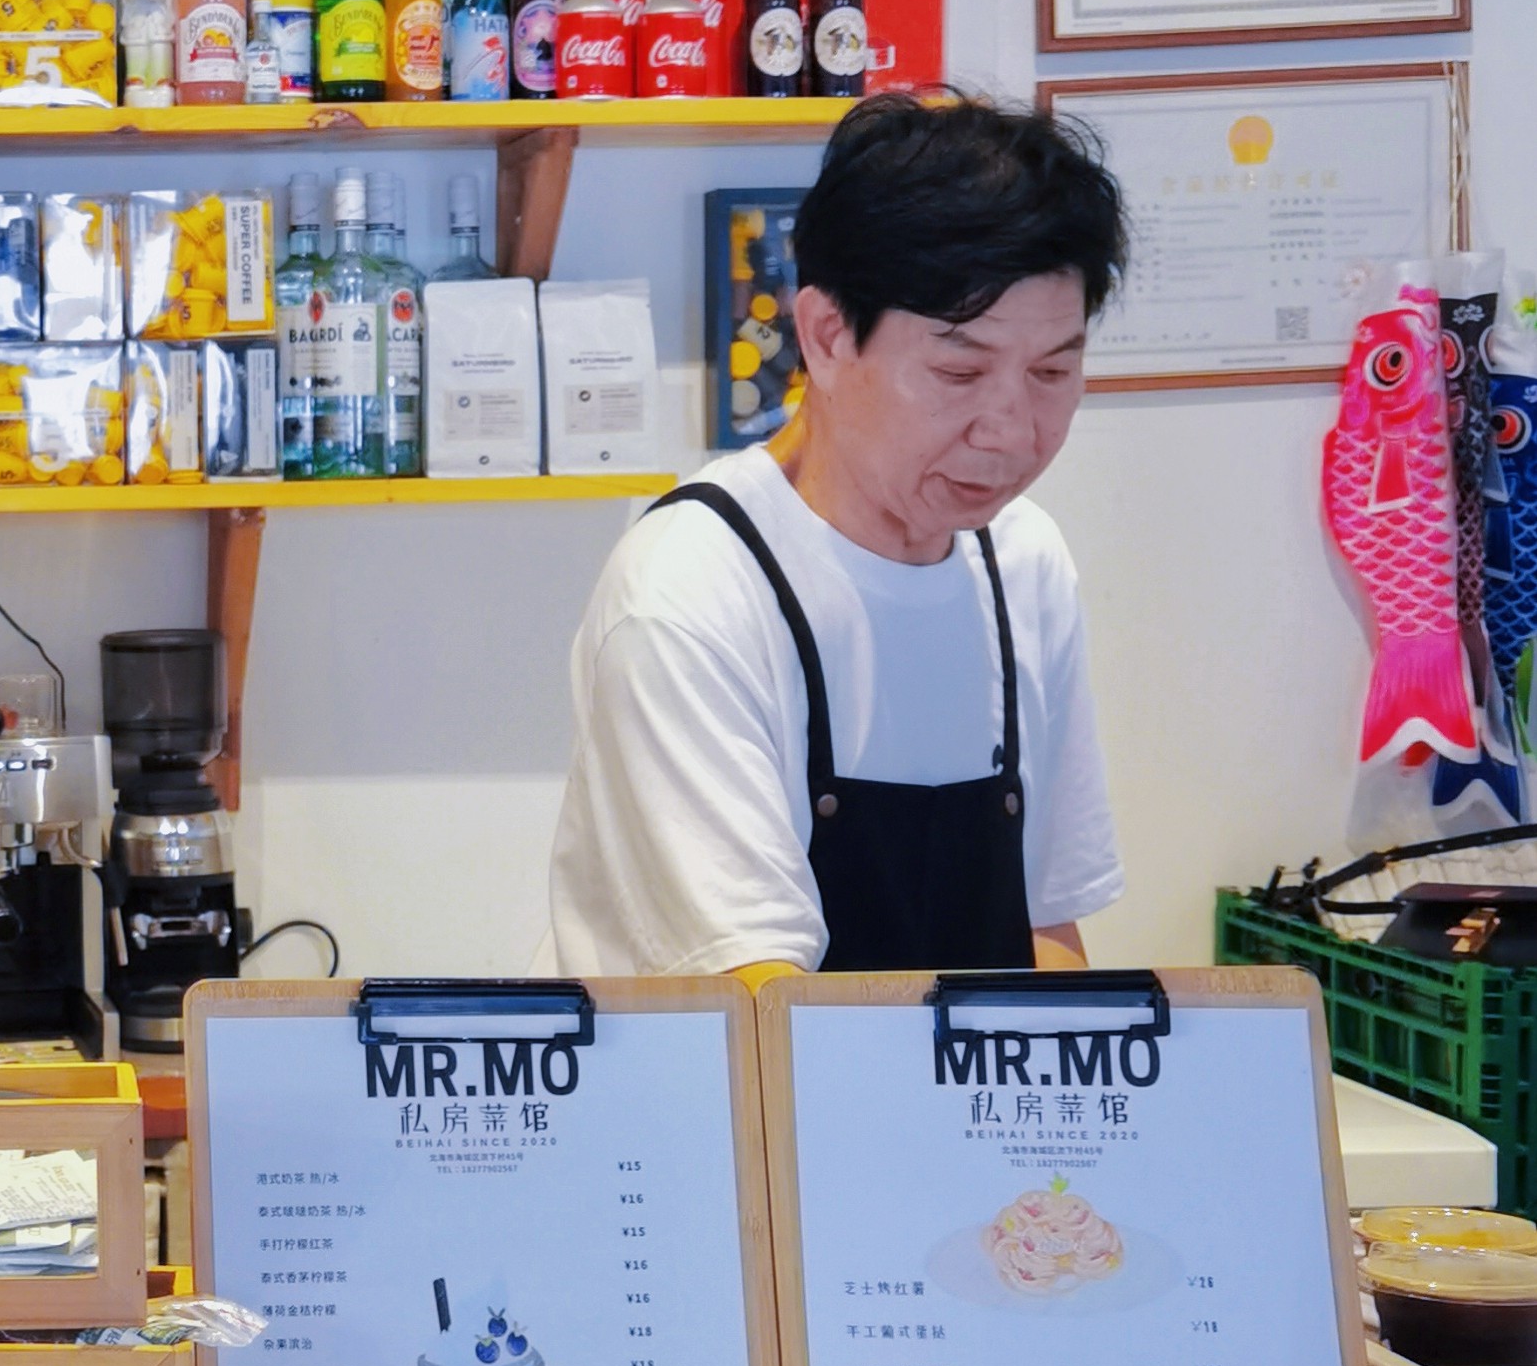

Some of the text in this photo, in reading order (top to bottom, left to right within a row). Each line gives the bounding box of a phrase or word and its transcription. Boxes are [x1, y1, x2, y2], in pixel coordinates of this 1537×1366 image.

[240, 206, 253, 305] SUPER COFFEE
[365, 1044, 580, 1098] MR.MO
[934, 1032, 1161, 1086] MR.MO
[399, 1102, 551, 1133] 私房菜馆
[970, 1092, 1129, 1125] 私房菜馆
[395, 1139, 452, 1148] BEIHAI
[462, 1138, 510, 1146] SINCE
[965, 1130, 1139, 1140] BEIHAI SINCE 2020
[257, 1173, 305, 1185] 港式奶茶
[260, 1238, 333, 1251] 手打柠檬红茶
